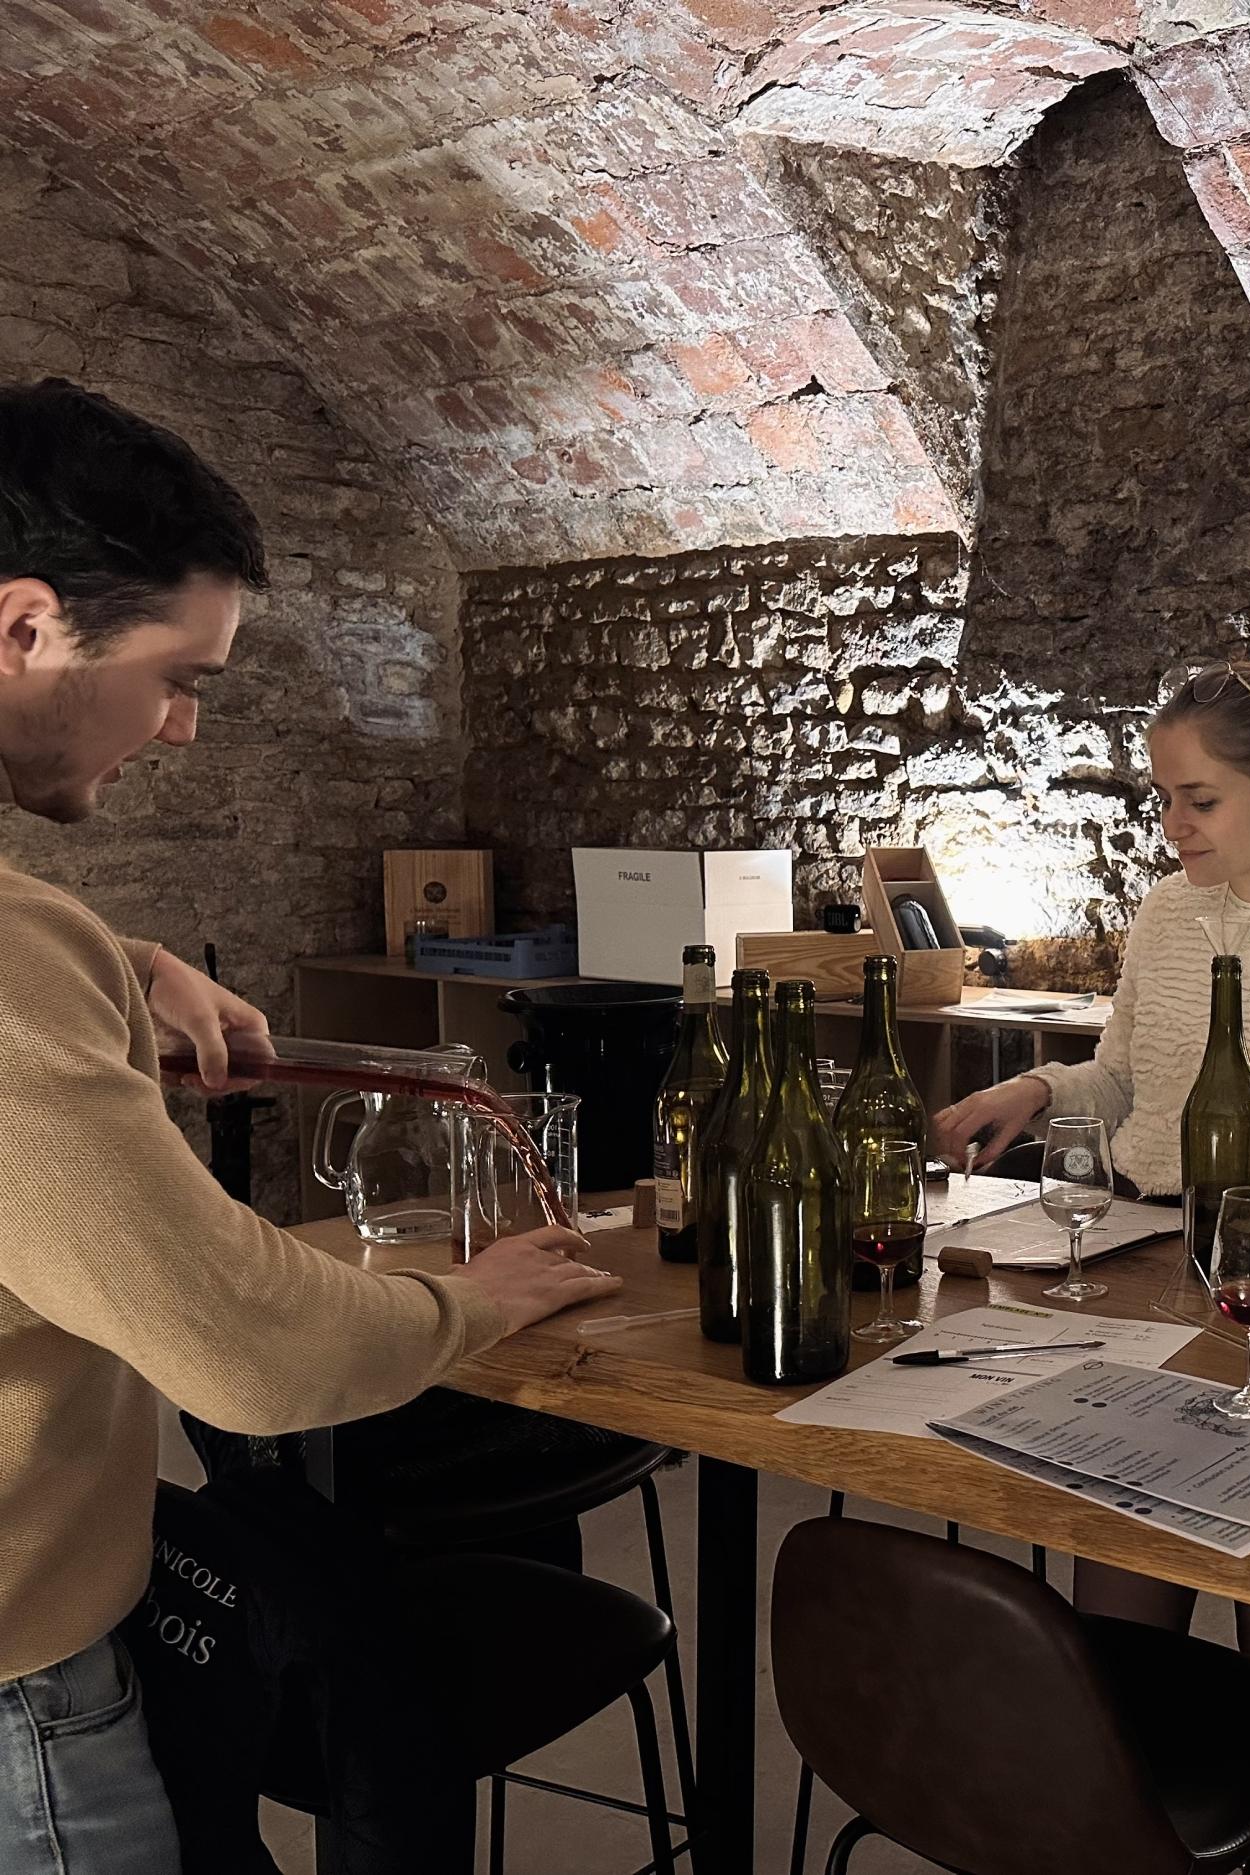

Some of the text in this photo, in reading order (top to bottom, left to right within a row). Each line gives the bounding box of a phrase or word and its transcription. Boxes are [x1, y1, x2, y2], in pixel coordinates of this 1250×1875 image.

[618, 871, 651, 882] FRAGILE
[827, 912, 848, 927] JBL
[969, 1373, 996, 1381] MON
[154, 1536, 238, 1608] NICOLE
[146, 1586, 217, 1665] bois
